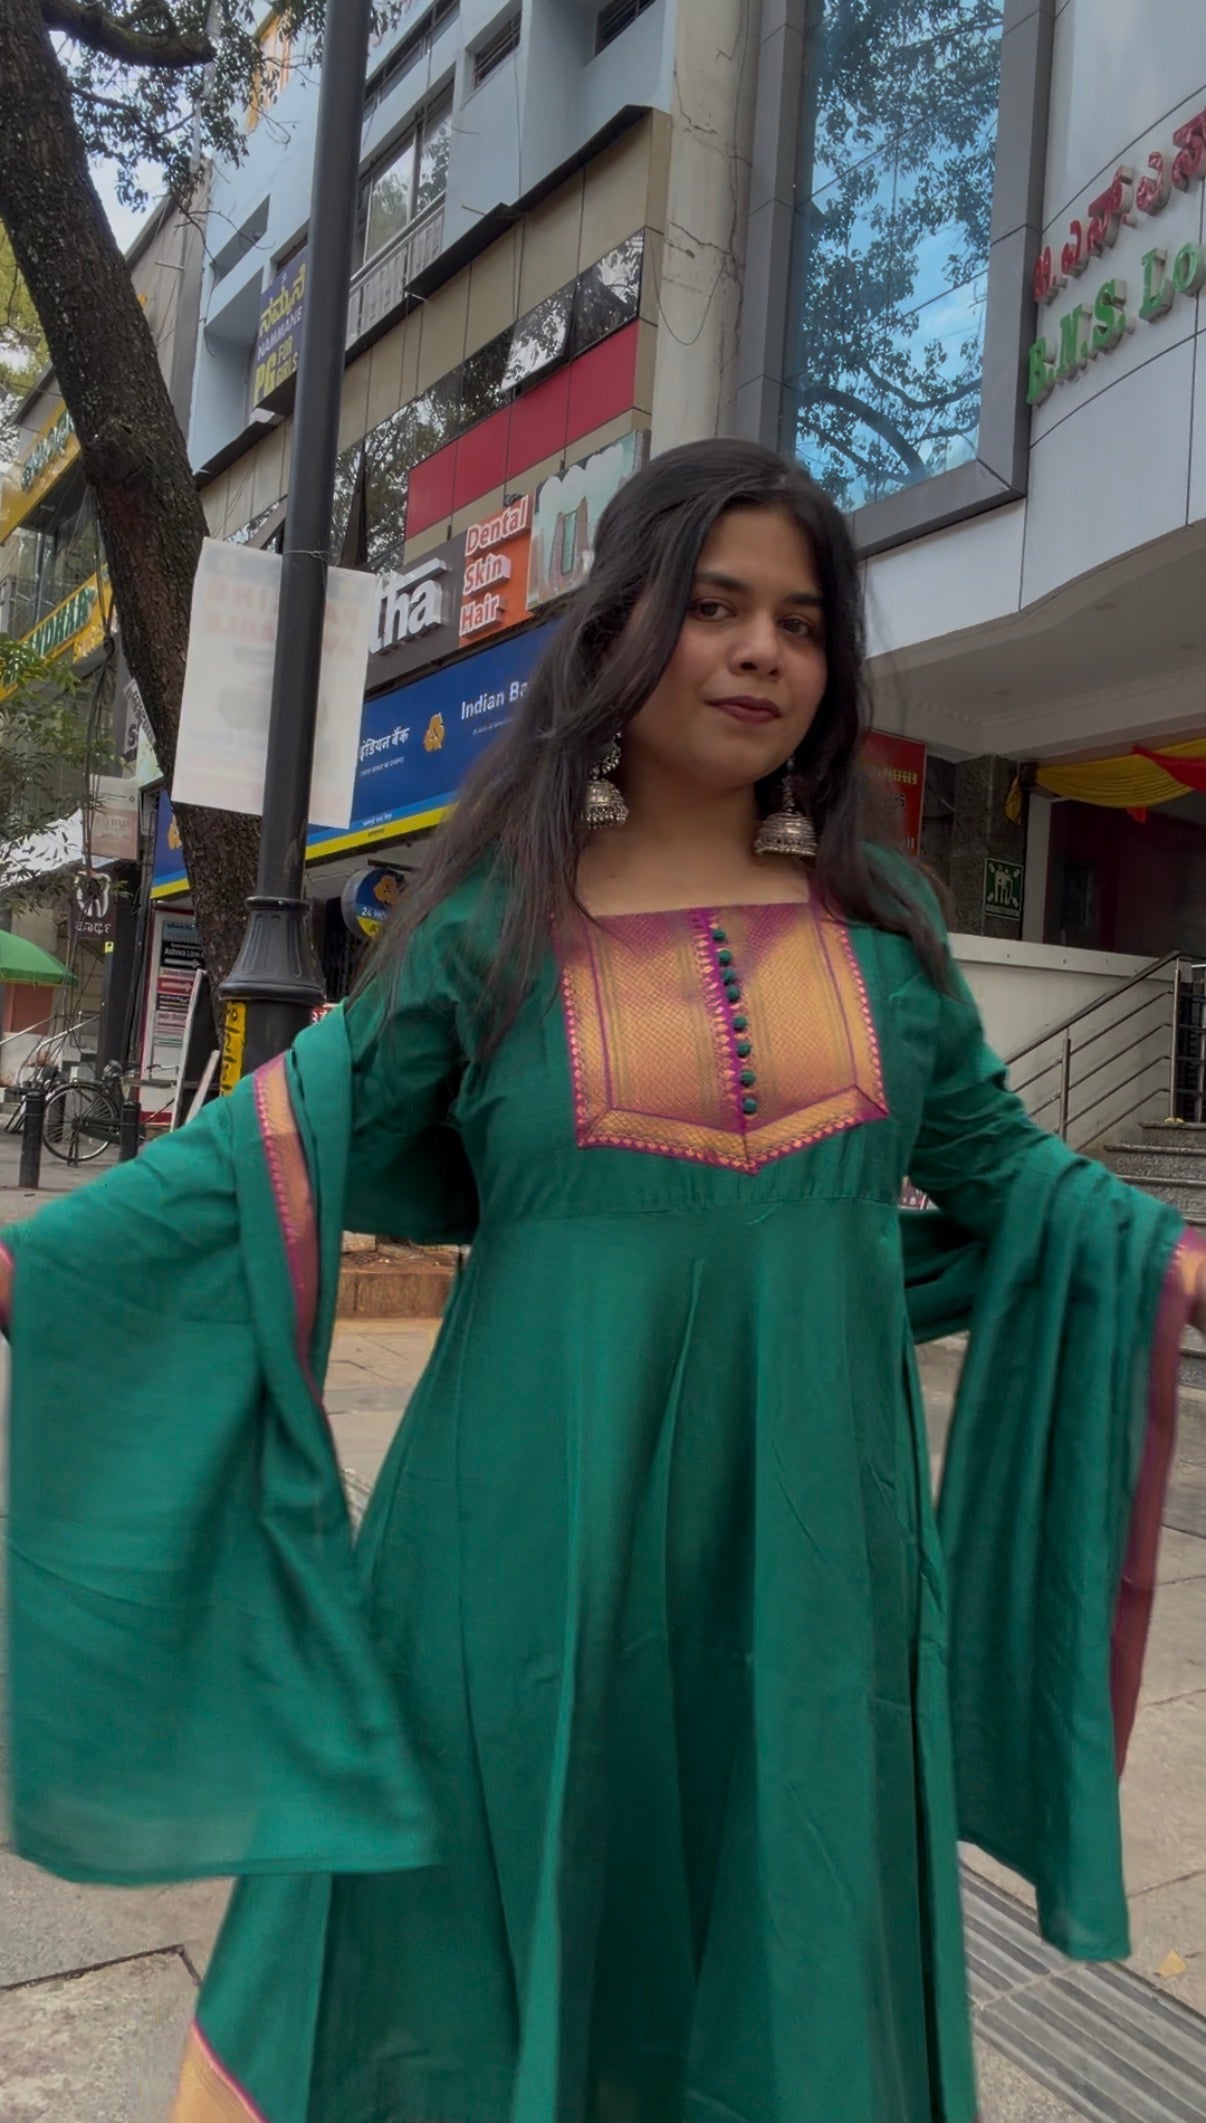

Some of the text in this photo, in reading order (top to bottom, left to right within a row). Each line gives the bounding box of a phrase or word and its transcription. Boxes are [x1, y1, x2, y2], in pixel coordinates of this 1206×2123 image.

[253, 352, 277, 408] PG
[464, 494, 529, 557] Dental
[462, 553, 505, 596] Skin
[459, 593, 501, 637] Hair
[460, 692, 505, 720] Indian
[391, 726, 410, 747] बैंक
